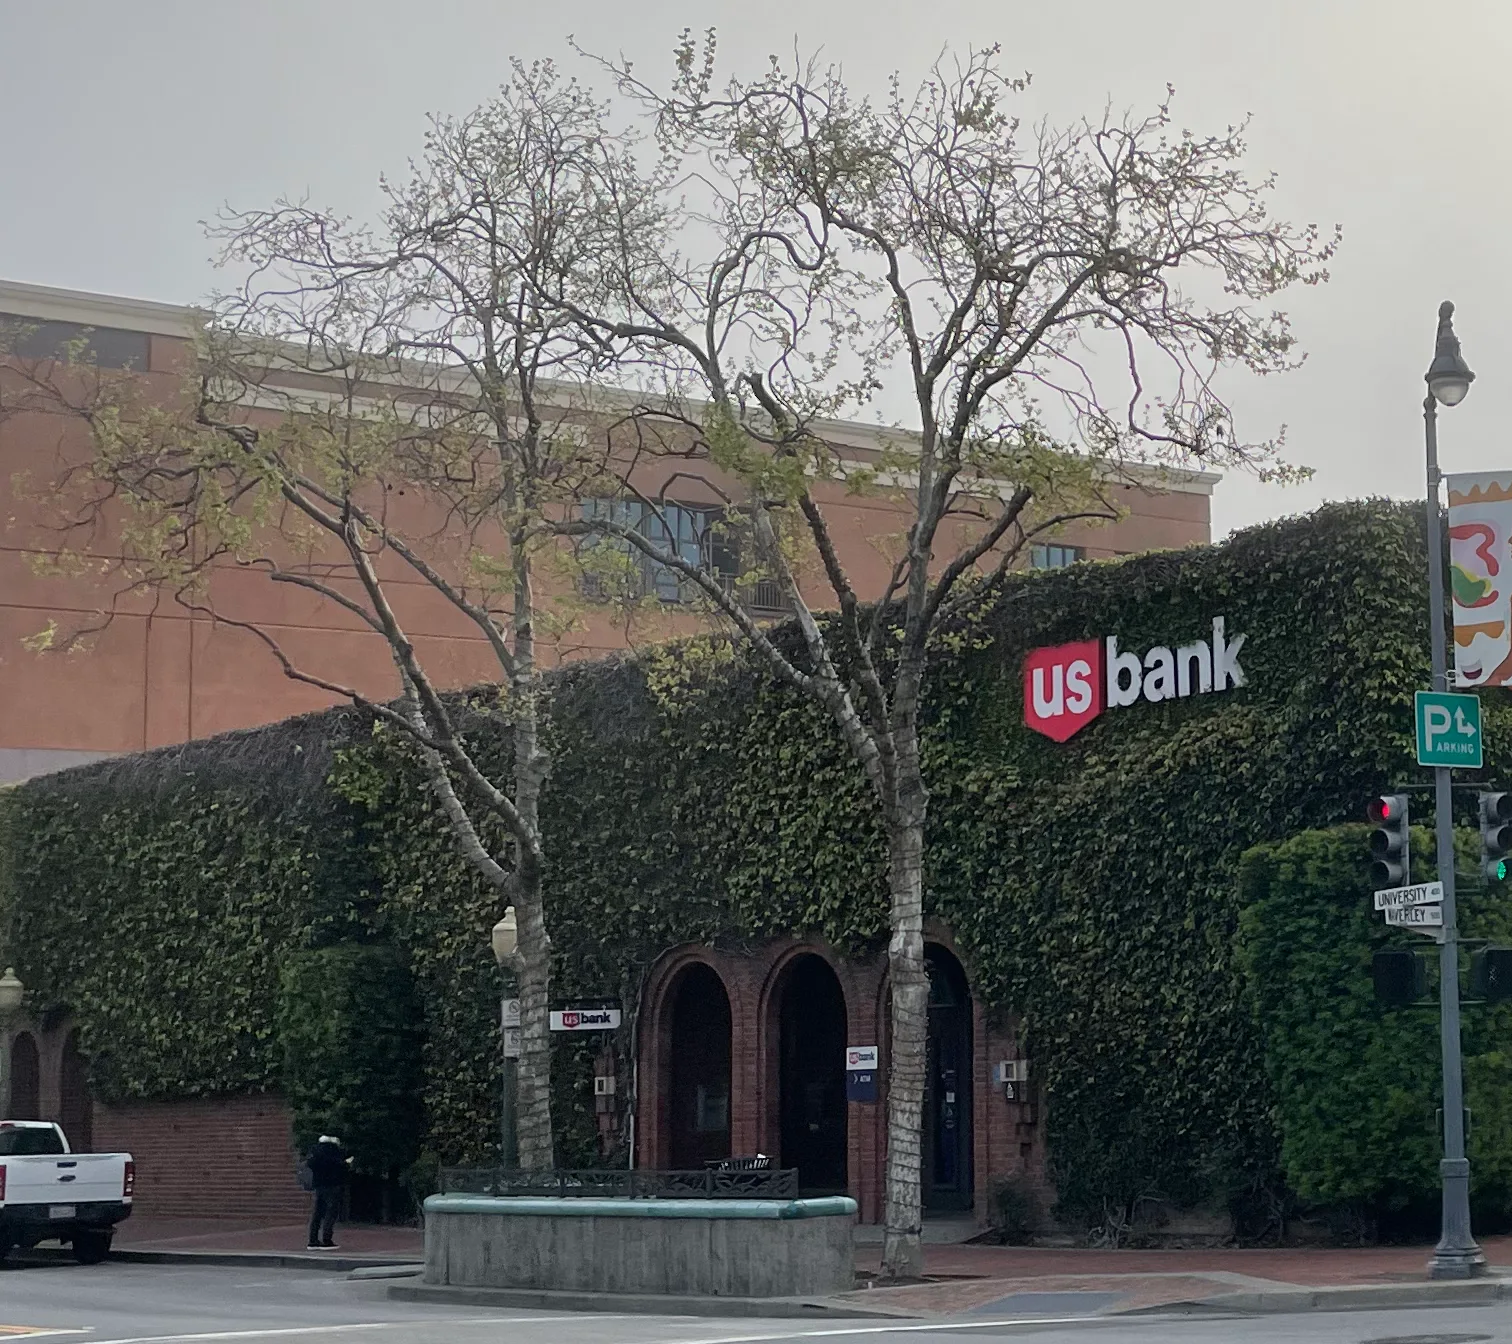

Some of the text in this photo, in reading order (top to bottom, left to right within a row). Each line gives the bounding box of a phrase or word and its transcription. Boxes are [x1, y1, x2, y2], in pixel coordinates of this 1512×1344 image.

[1032, 615, 1249, 719] us bank
[1378, 886, 1428, 907] UNIVERSITY
